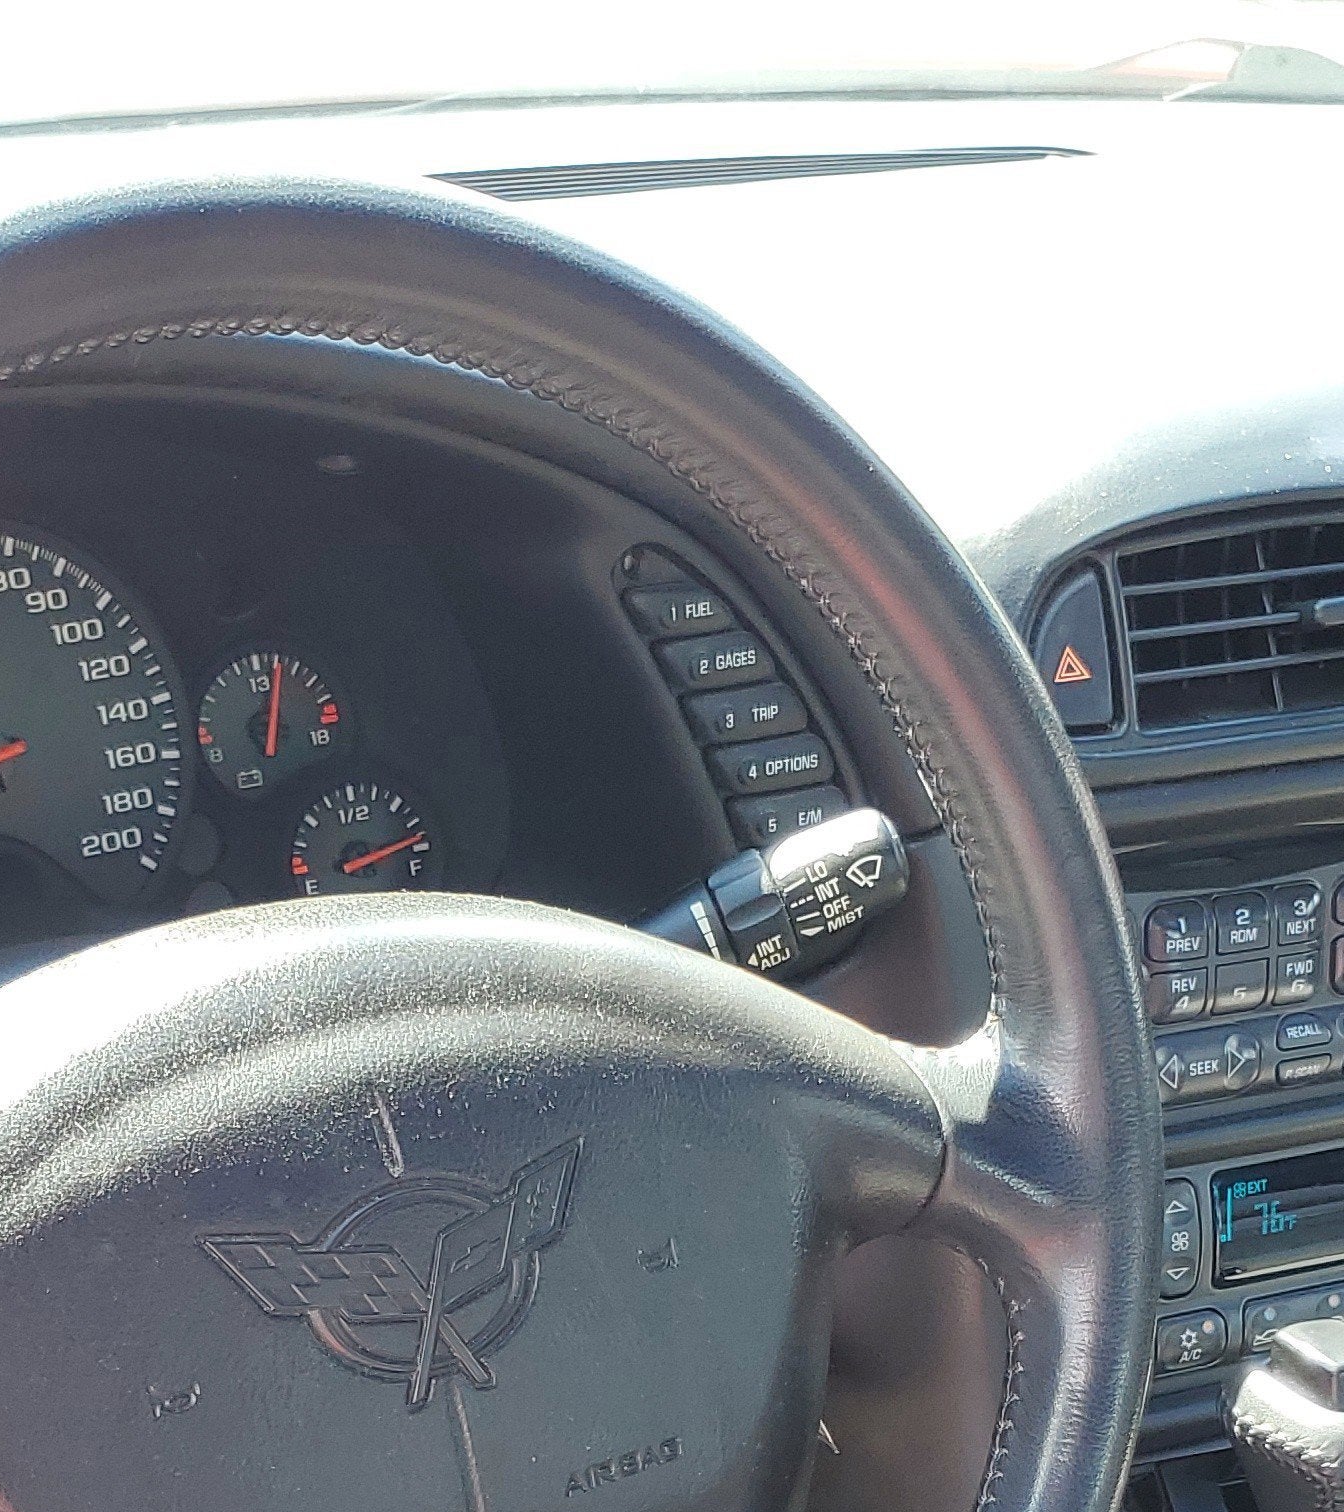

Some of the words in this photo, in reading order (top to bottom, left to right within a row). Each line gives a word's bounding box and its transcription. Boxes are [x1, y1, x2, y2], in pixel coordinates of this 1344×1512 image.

[24, 588, 69, 613] 90
[685, 601, 714, 619] FUEL
[50, 618, 105, 646] 100
[78, 655, 131, 683] 120
[699, 660, 709, 675] 2
[716, 649, 756, 670] GAGES
[249, 675, 270, 693] 13
[96, 699, 149, 725] 140
[725, 713, 735, 729] 3
[752, 705, 778, 722] TRIP
[309, 729, 331, 747] 18
[104, 742, 157, 770] 160
[748, 765, 758, 780] 4
[765, 753, 818, 776] OPTIONS
[101, 787, 154, 815] 180
[338, 805, 369, 825] 1/2
[768, 817, 777, 833] 5
[798, 808, 823, 826] E/M
[81, 827, 142, 857] 200
[410, 860, 422, 877] F
[804, 860, 828, 883] LO
[307, 880, 319, 895] E
[814, 877, 839, 903] INT
[822, 894, 852, 919] OFF
[1235, 908, 1250, 925] 2
[1294, 899, 1307, 916] 3
[826, 905, 864, 934] MIST
[1286, 918, 1317, 936] NEXT
[756, 934, 782, 958] INT
[1166, 937, 1200, 954] PREV
[1230, 928, 1258, 945] RDM
[760, 947, 792, 971] ADJ
[1285, 959, 1313, 977] FWD
[1171, 978, 1197, 993] REV
[1233, 987, 1247, 1001] 5
[1286, 1023, 1323, 1039] RECALL
[1189, 1060, 1219, 1077] SEEK
[1247, 1179, 1268, 1194] EXT
[1178, 1349, 1202, 1363] A/C
[565, 1437, 683, 1498] AIRBAG
